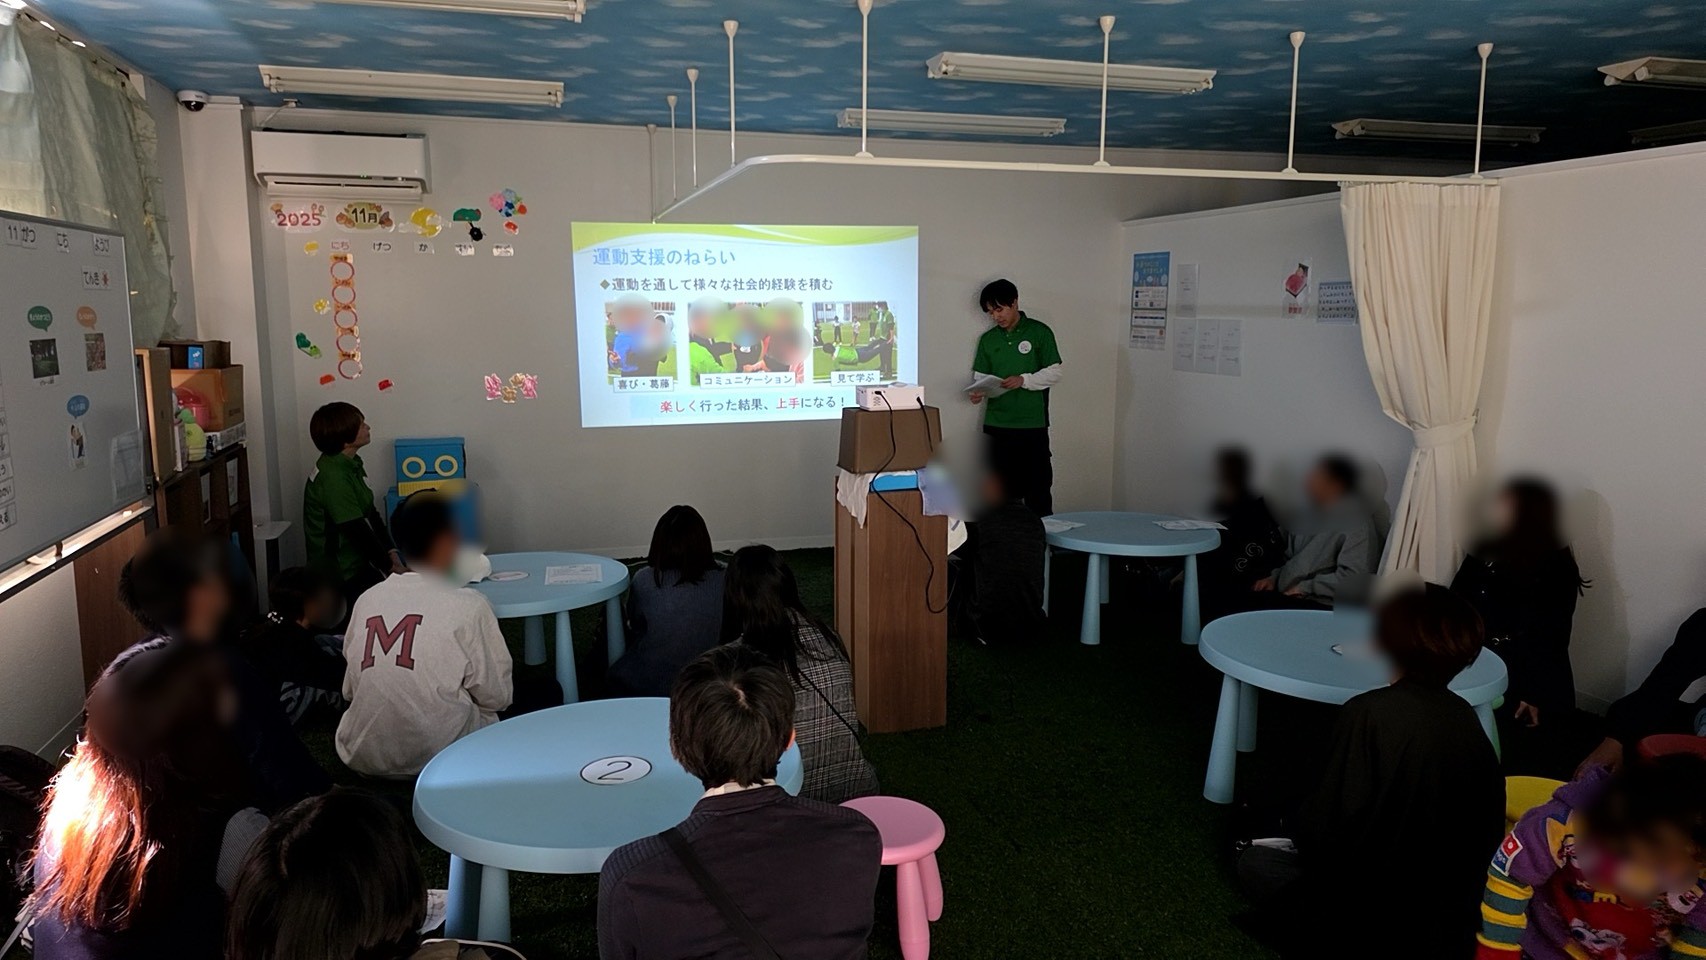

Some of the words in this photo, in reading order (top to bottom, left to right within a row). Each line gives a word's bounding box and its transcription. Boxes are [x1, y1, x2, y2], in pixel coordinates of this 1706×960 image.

[276, 213, 322, 227] 2025
[351, 207, 378, 223] 11月
[57, 232, 69, 248] にち
[331, 241, 350, 251] にち
[373, 242, 392, 251] げつ
[419, 243, 428, 252] か
[592, 247, 736, 266] 運動支援のねらい
[83, 271, 100, 286] てんき
[611, 277, 834, 292] 運動を通して様々な社会的経験を積む
[617, 378, 671, 390] 喜び・葛藤
[703, 374, 794, 387] コミュニケーション
[836, 372, 875, 384] 見て学ぶ
[361, 614, 423, 672] M
[597, 760, 632, 781] 2
